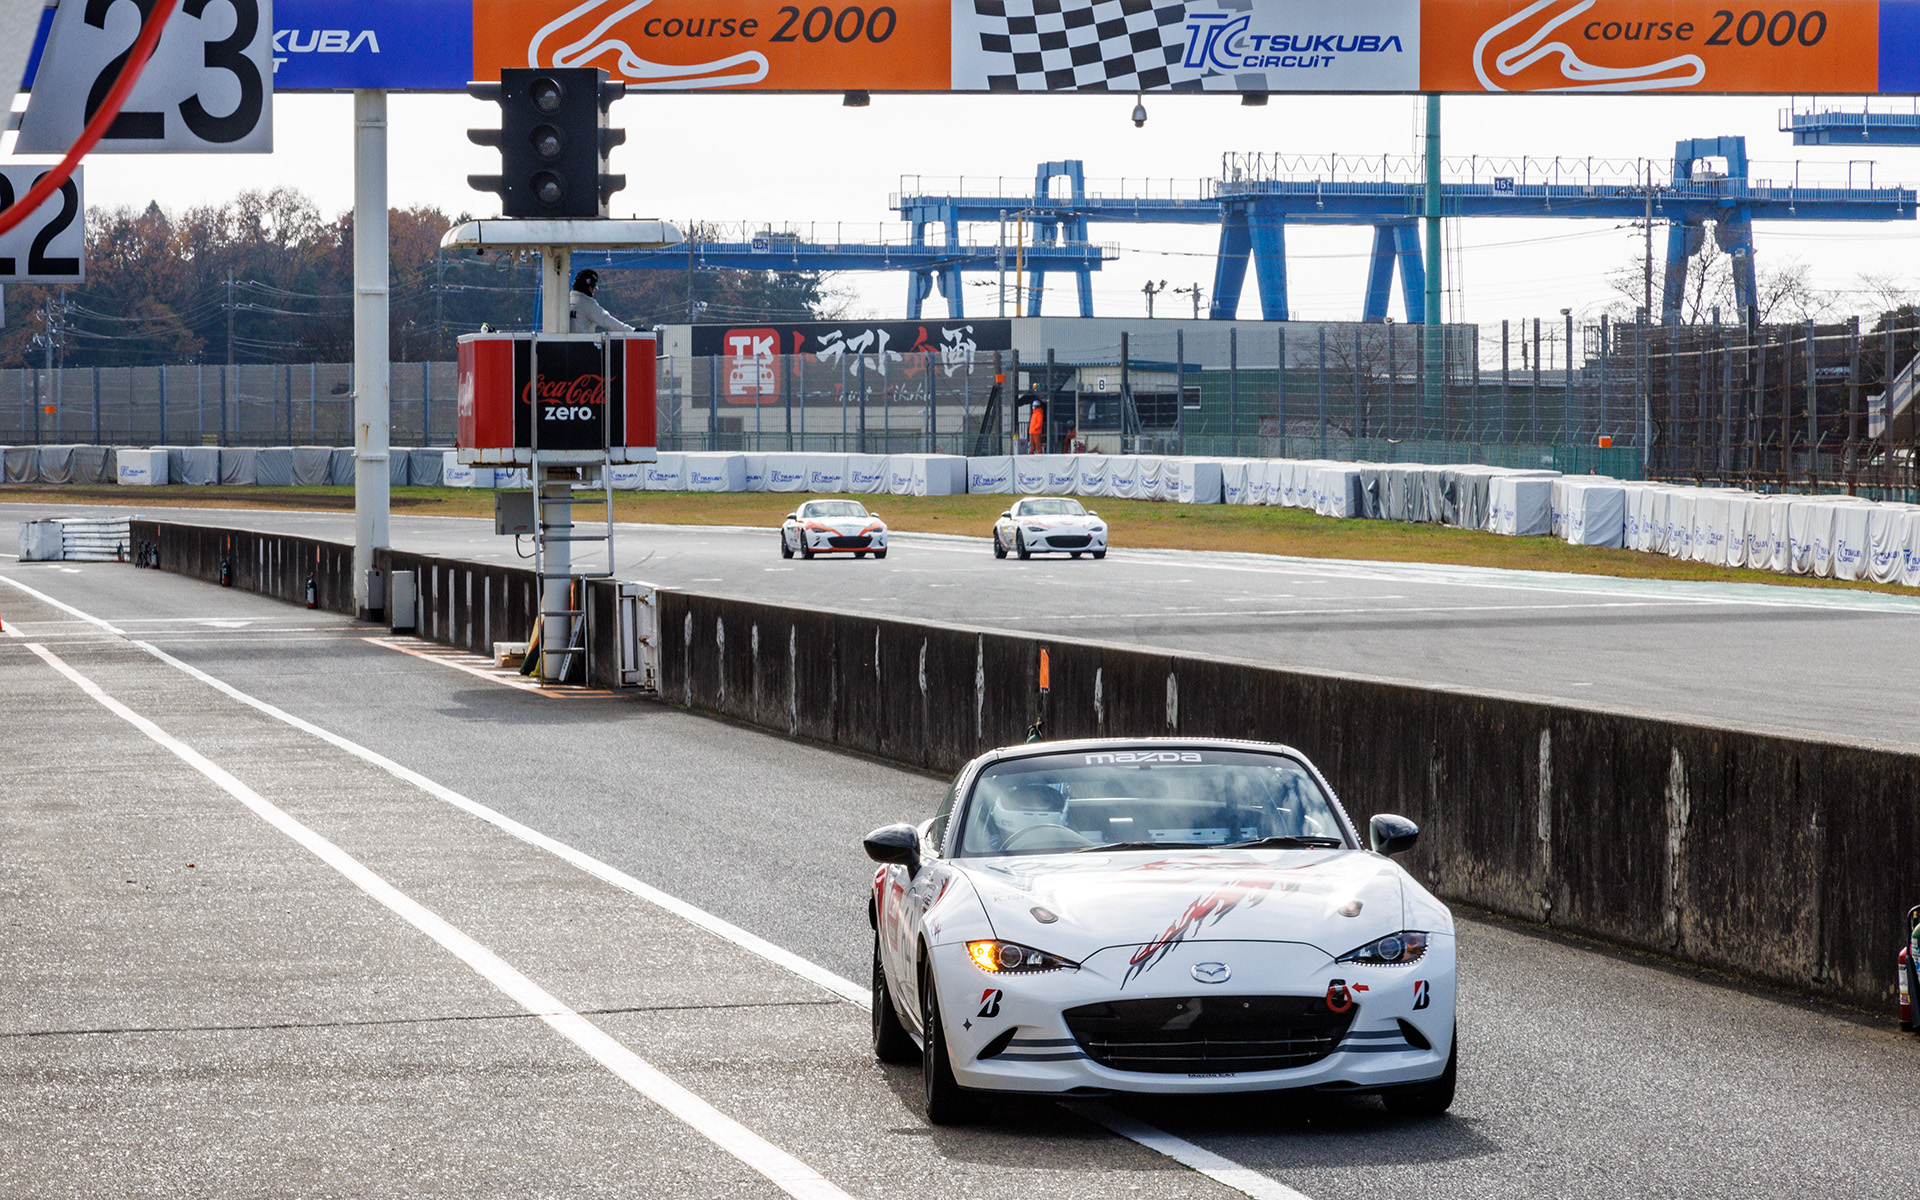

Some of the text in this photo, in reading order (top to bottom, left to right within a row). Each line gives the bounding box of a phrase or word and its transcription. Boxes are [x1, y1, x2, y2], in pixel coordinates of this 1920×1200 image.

[643, 5, 897, 43] course 2000
[1583, 9, 1828, 47] course 2000
[1250, 35, 1403, 53] TSUKUBA
[83, 0, 263, 143] 23
[728, 335, 775, 364] TK
[522, 373, 617, 405] Coca-Cola
[1085, 752, 1202, 765] mazda
